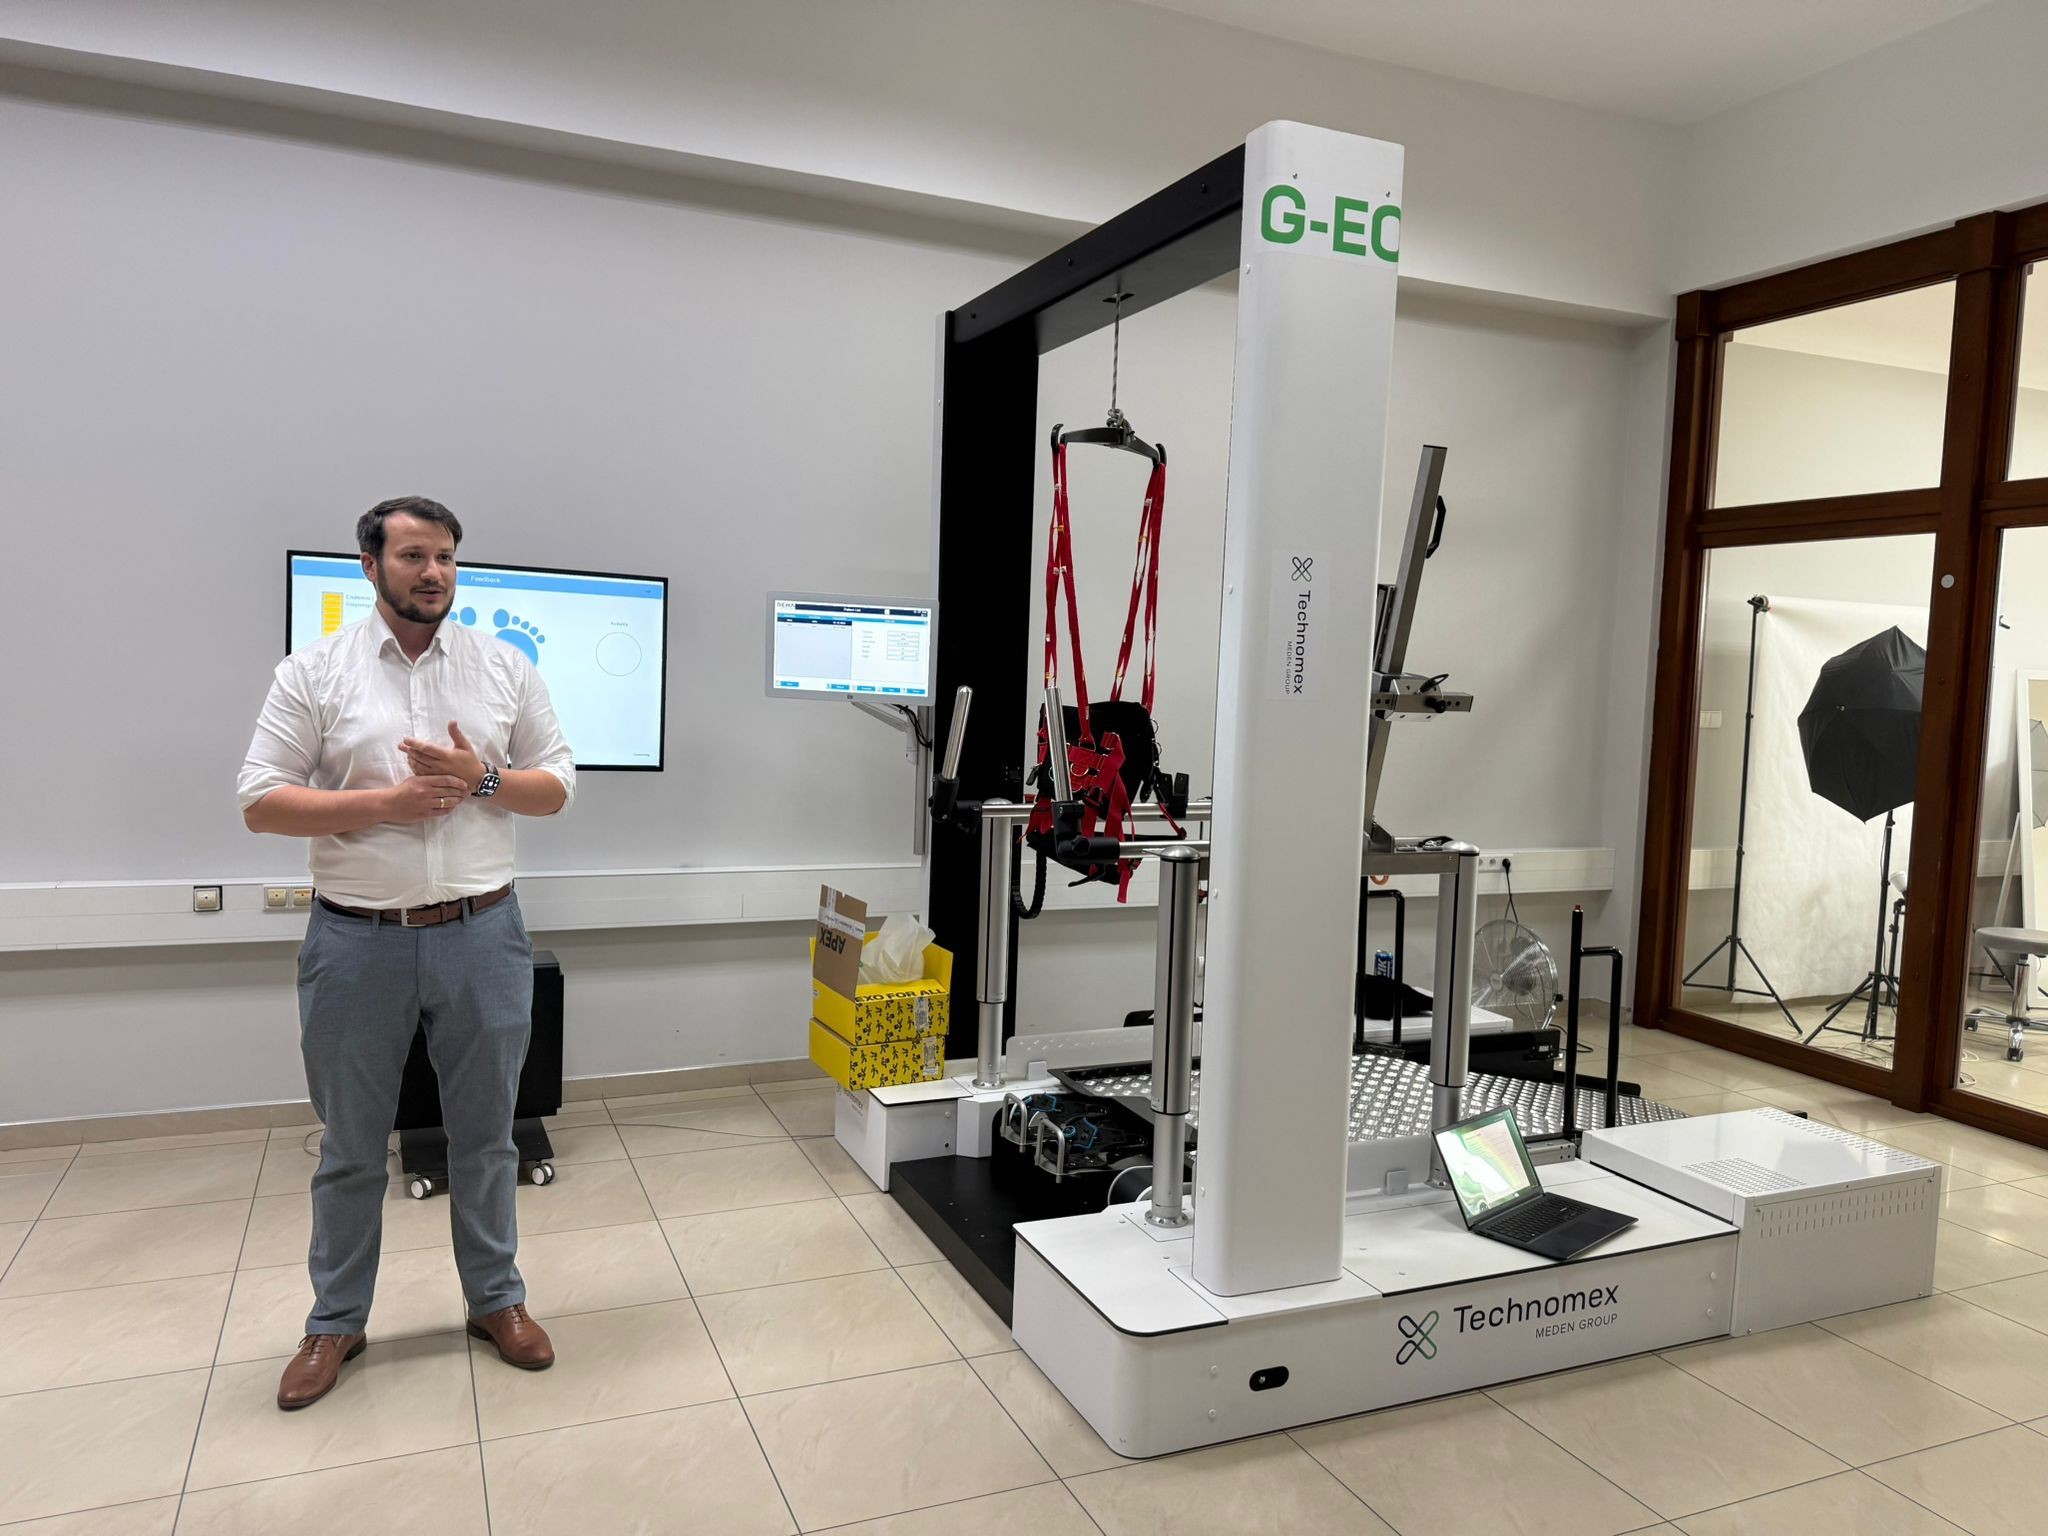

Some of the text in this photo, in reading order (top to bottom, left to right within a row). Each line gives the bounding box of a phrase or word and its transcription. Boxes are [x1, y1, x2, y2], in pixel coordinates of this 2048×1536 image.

[1293, 590, 1311, 694] Technomex
[819, 927, 847, 955] APEX
[886, 990, 918, 999] FOR
[920, 988, 946, 996] ALL
[1453, 1284, 1619, 1333] Technomex
[1535, 1312, 1618, 1339] MEDEN GROUP
